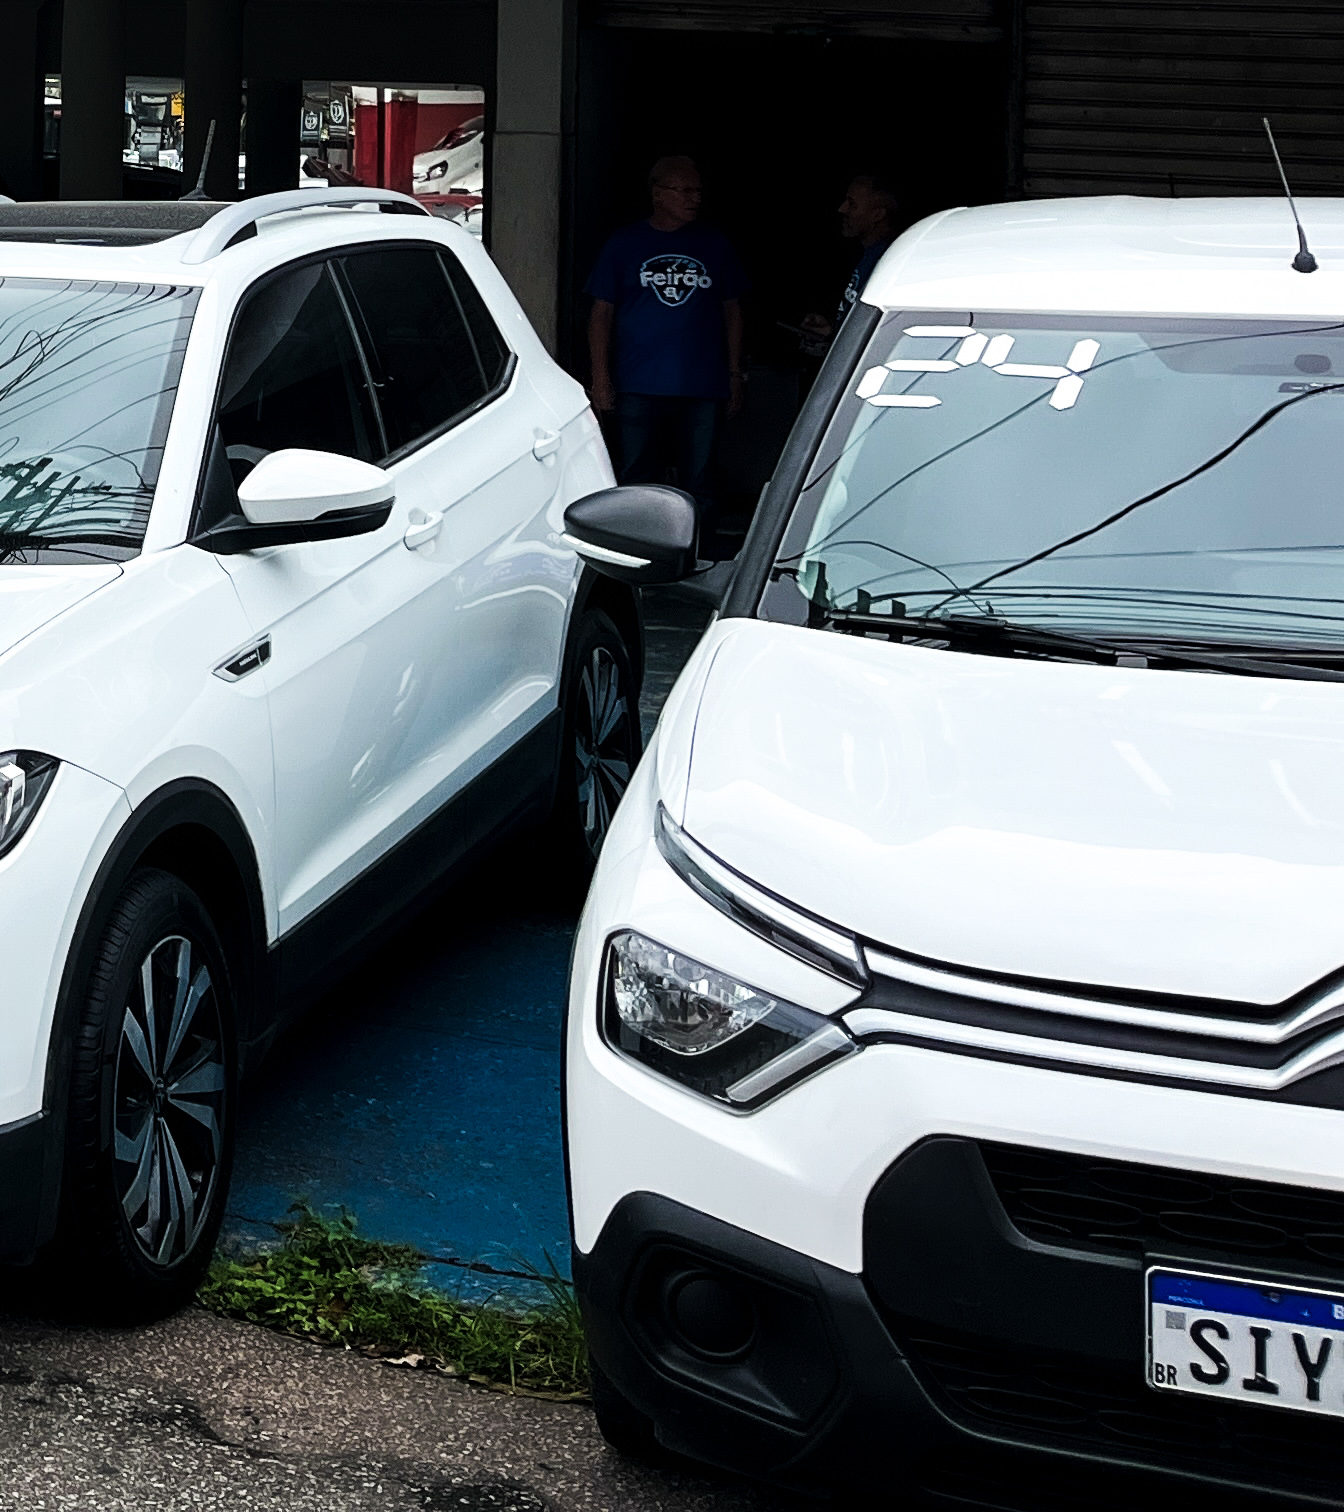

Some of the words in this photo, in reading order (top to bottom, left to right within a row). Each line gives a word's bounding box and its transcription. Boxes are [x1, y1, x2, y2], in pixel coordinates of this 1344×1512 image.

[639, 267, 713, 289] Feirão
[855, 324, 1101, 412] 24
[1154, 1362, 1178, 1386] BR
[1189, 1318, 1333, 1402] SIY
